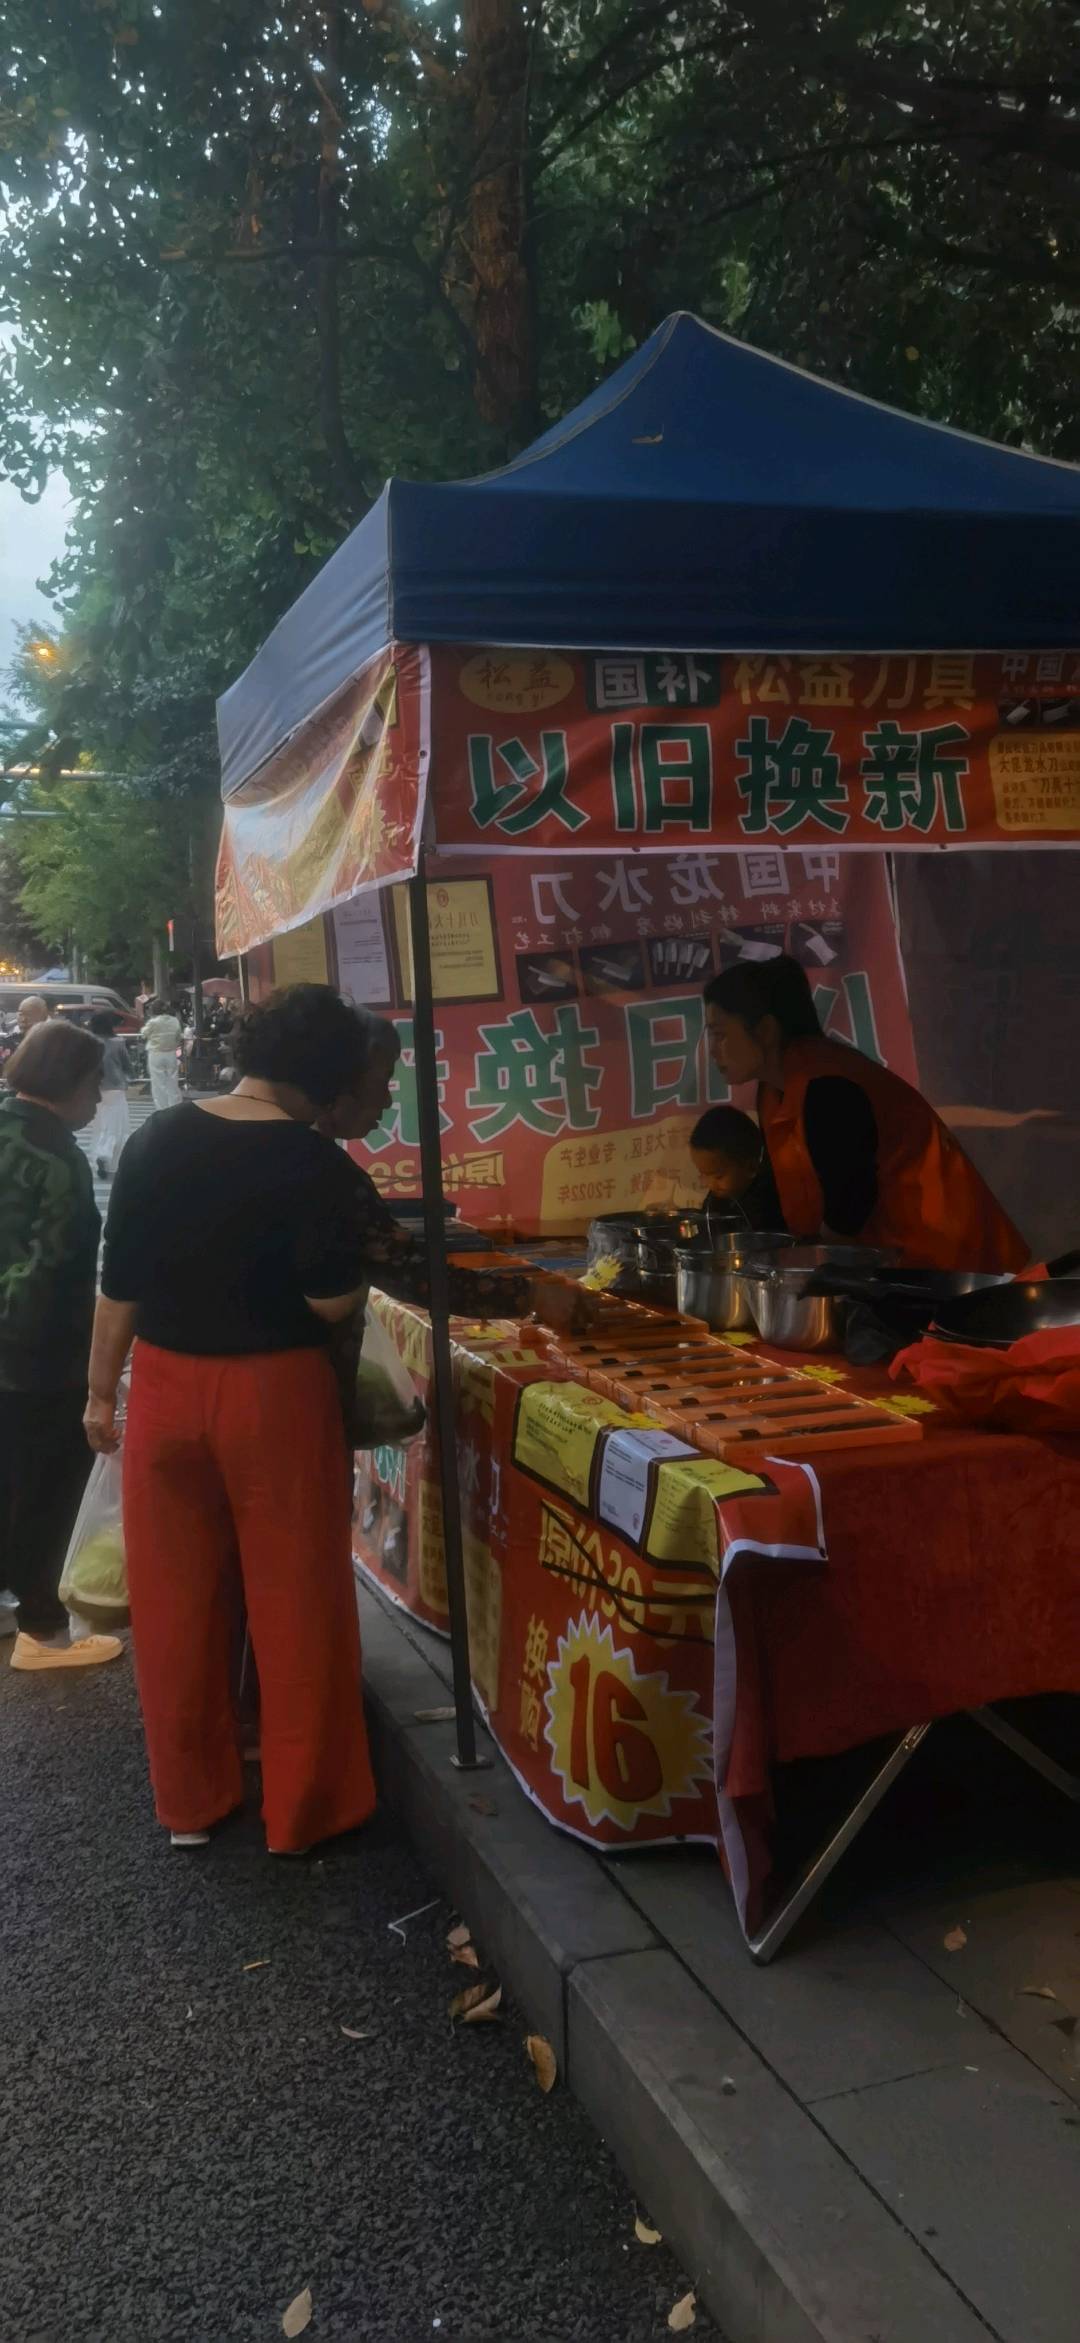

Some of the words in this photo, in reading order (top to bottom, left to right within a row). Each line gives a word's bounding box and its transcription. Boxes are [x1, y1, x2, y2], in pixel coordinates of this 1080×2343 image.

[595, 655, 713, 709] 国补
[733, 653, 977, 712] 松益刀具
[466, 716, 972, 834] 以旧换新
[569, 1653, 665, 1803] 16
